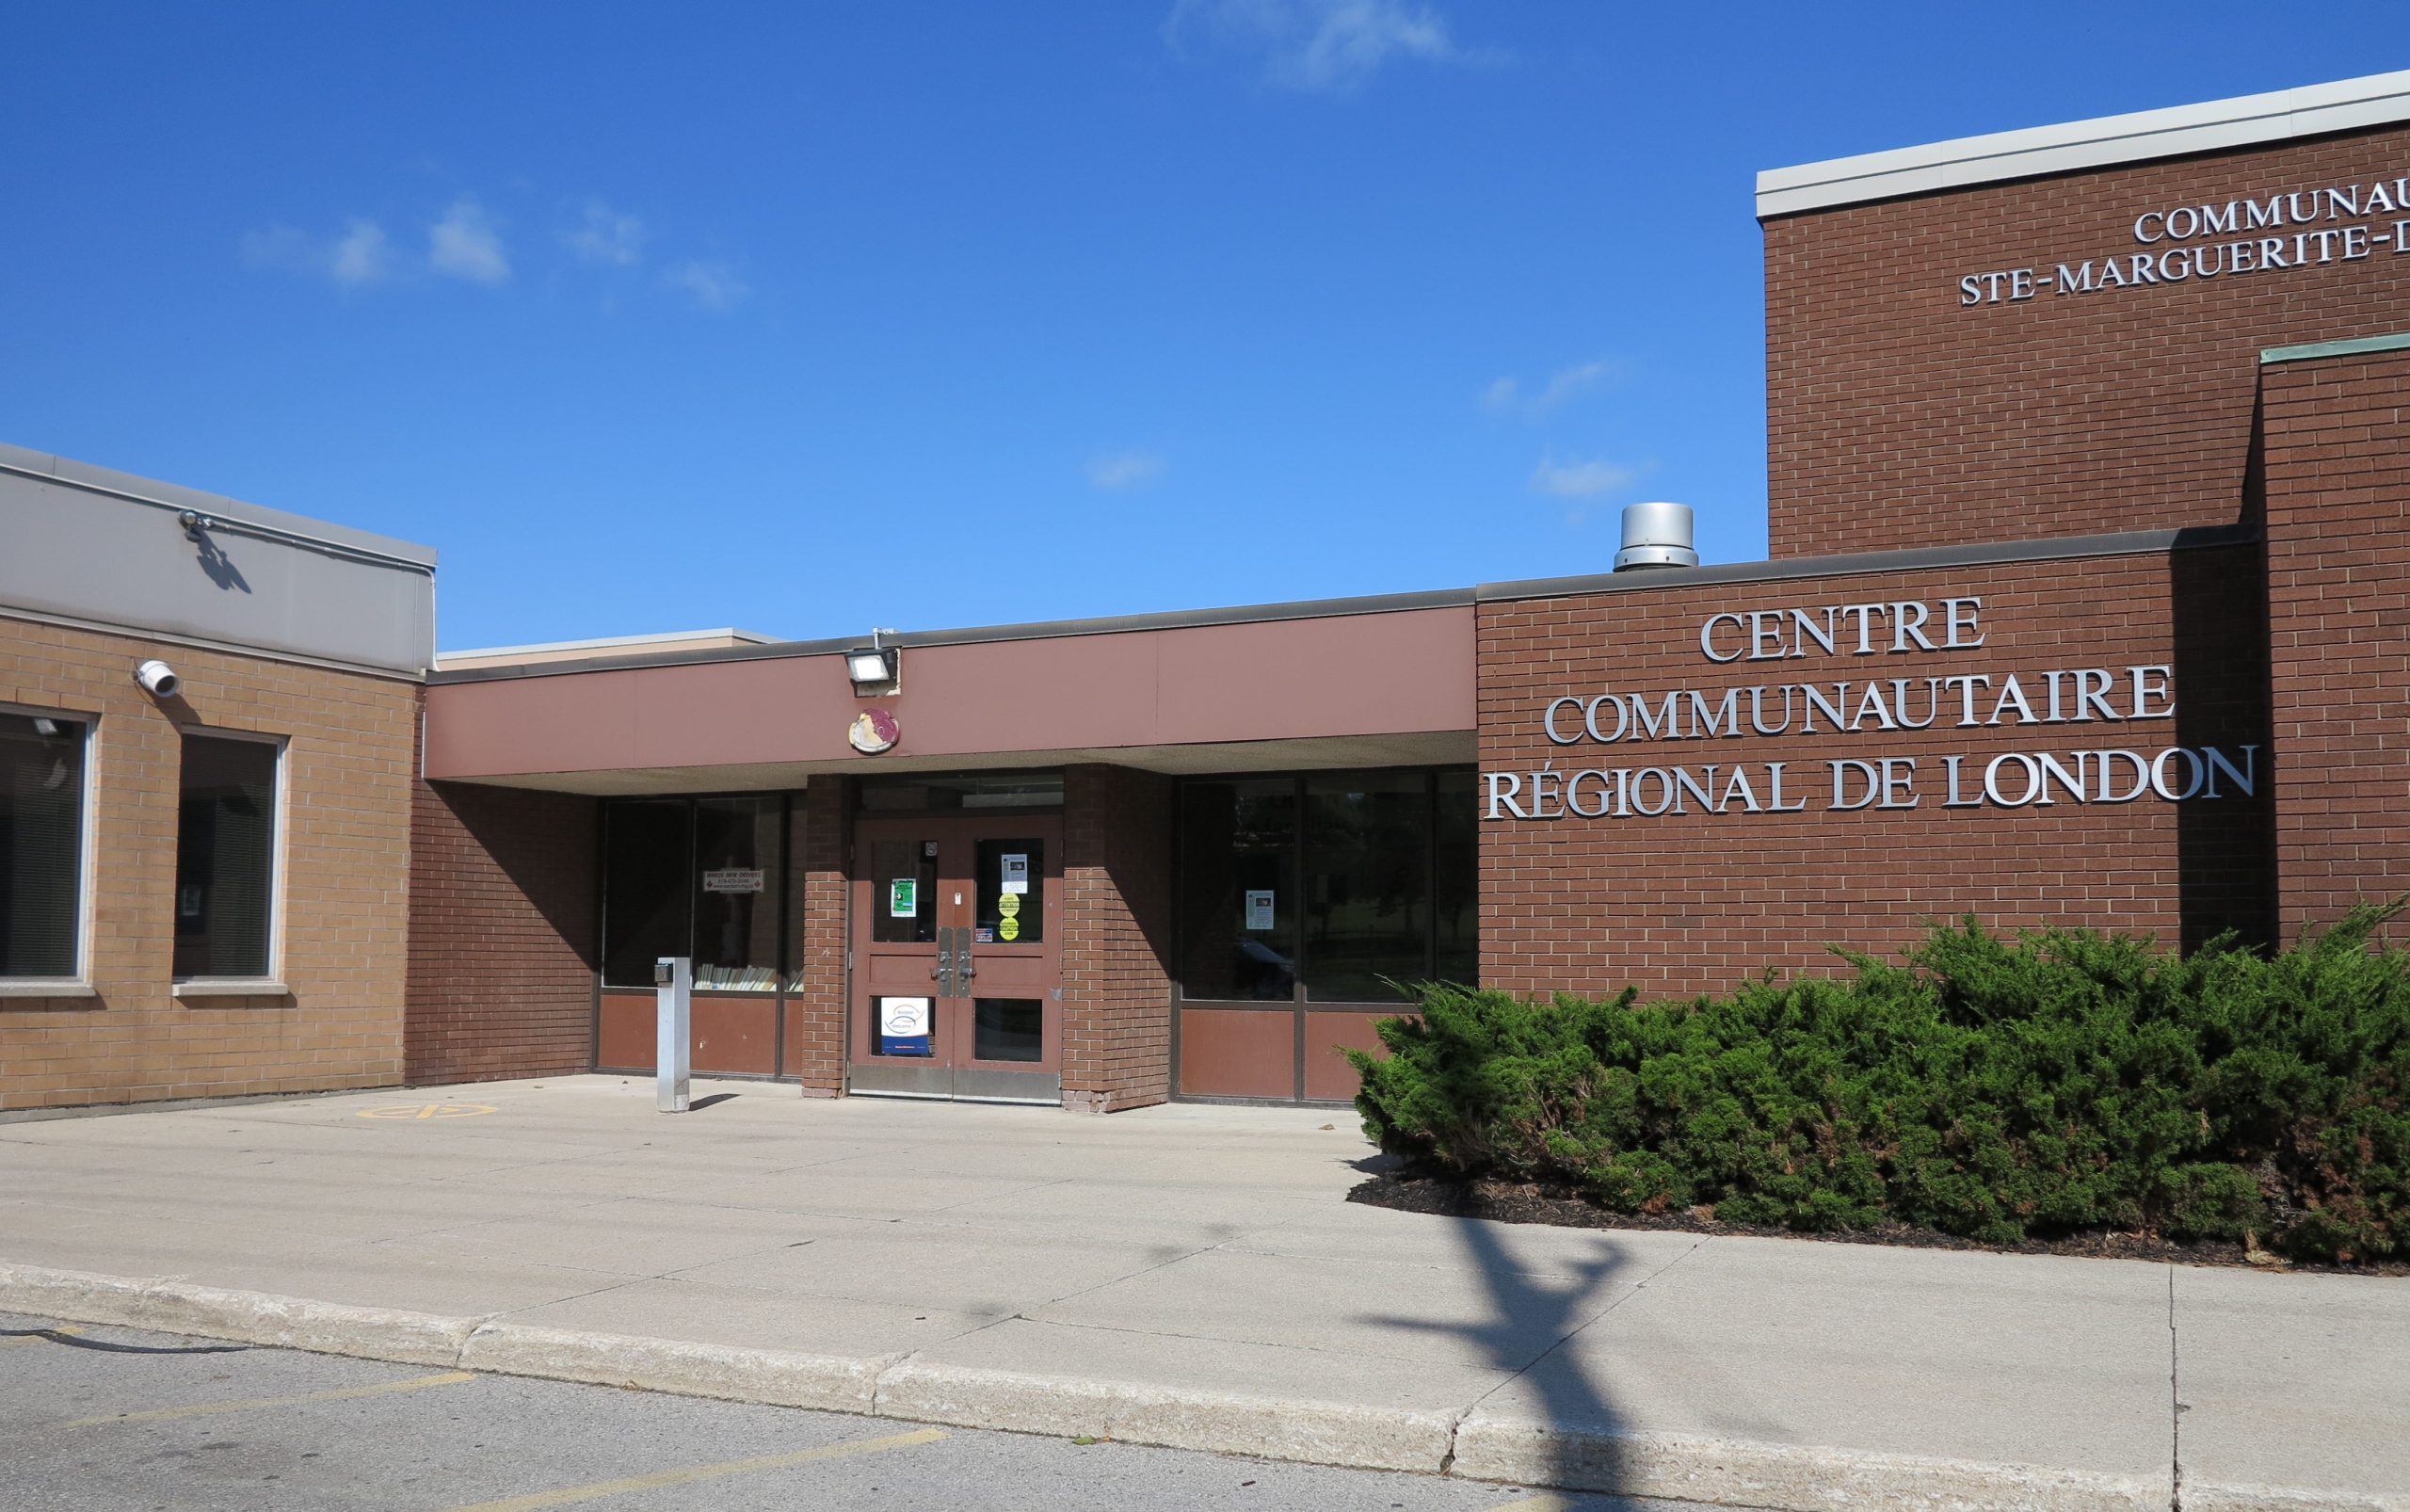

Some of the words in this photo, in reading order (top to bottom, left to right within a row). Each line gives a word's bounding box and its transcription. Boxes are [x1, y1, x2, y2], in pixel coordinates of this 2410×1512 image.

[1700, 597, 1986, 661] CENTRE
[1544, 665, 2176, 744] COMMUNAUTAIRE
[1483, 761, 1808, 819] RÉGIONAL
[1826, 757, 1920, 810] DE
[1940, 745, 2259, 807] LONDON
